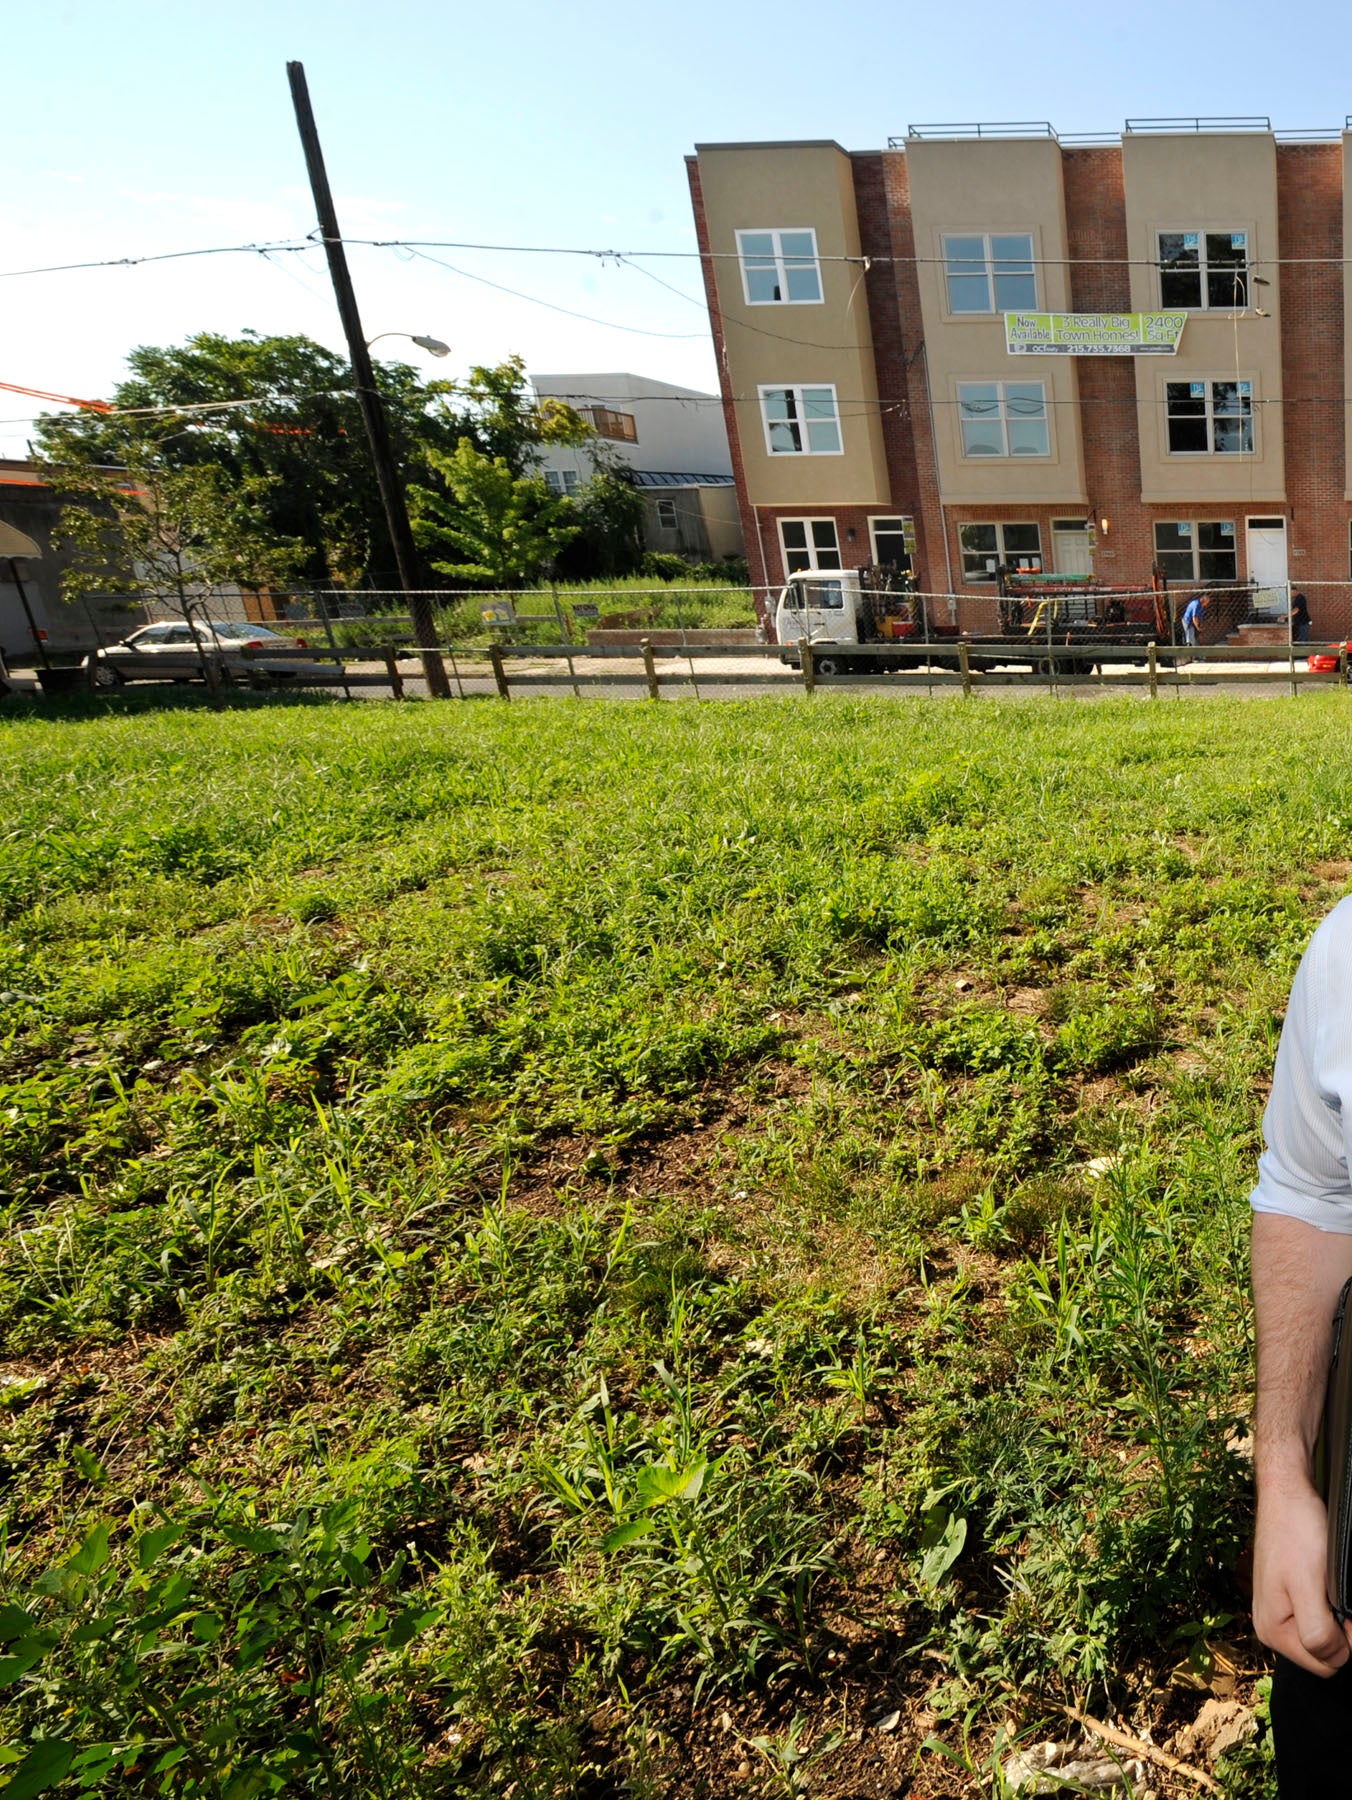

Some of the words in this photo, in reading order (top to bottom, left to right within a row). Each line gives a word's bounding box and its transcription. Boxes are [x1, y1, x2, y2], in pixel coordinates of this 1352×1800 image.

[1017, 316, 1036, 327] Now
[1064, 316, 1070, 328] 3
[1073, 316, 1108, 329] Really
[1112, 316, 1130, 329] Big
[1145, 316, 1183, 329] 2400
[1011, 327, 1050, 339] Available
[1056, 329, 1090, 340] Town
[1093, 329, 1138, 340] Homes!
